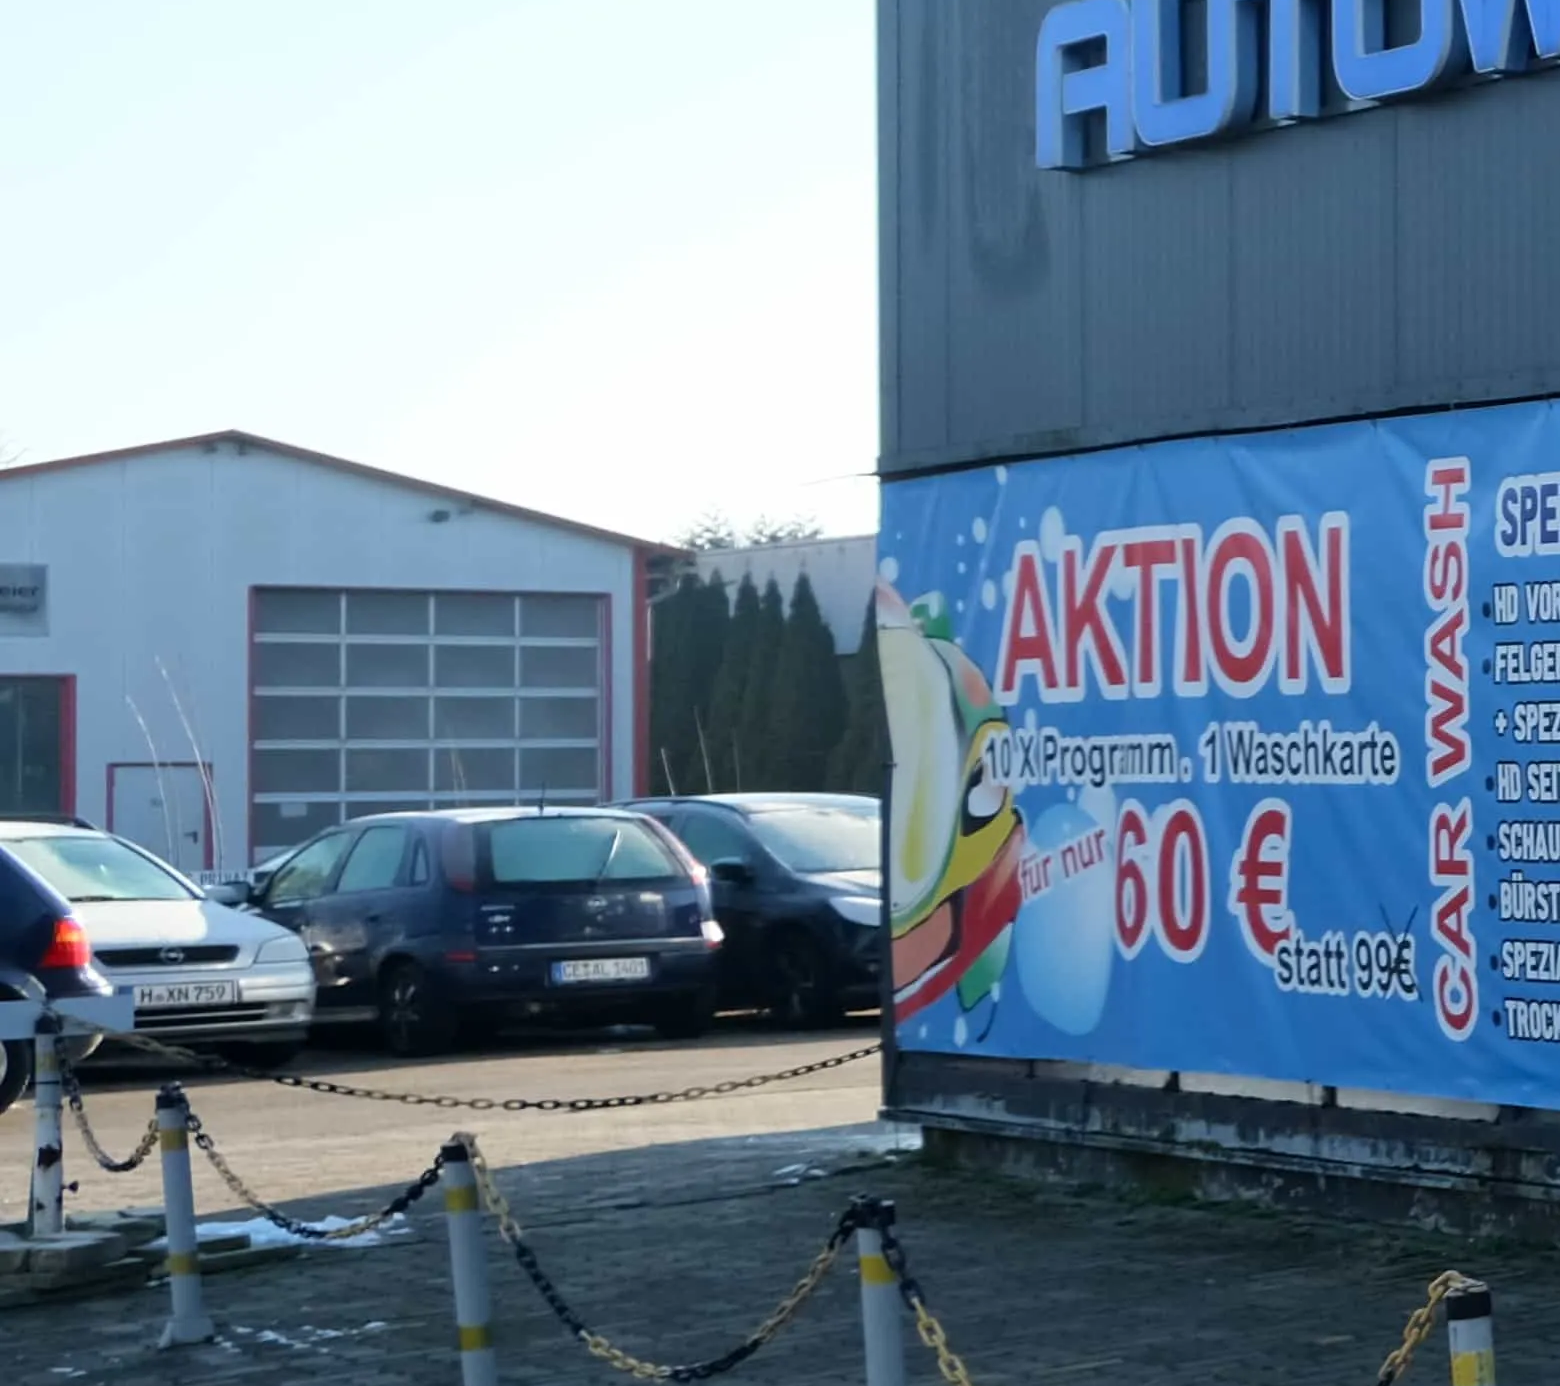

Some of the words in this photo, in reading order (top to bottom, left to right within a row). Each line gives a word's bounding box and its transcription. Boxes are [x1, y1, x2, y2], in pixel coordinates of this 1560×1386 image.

[1001, 526, 1344, 693] AKTION
[1430, 466, 1466, 777] WASH
[1494, 588, 1518, 622] HD
[1495, 714, 1508, 737] +
[985, 737, 1010, 778] 10
[1018, 737, 1036, 776] X
[1205, 734, 1218, 775] 1
[1227, 727, 1395, 776] Waschkarte
[1498, 765, 1521, 802] HD
[1021, 851, 1050, 900] für
[1061, 830, 1106, 878] nur
[1116, 809, 1204, 951] 60
[1237, 809, 1291, 955] €
[1432, 805, 1474, 1031] CAR
[1277, 938, 1346, 988] statt
[141, 989, 152, 1002] H
[167, 987, 189, 1001] XN
[195, 985, 225, 1001] 759
